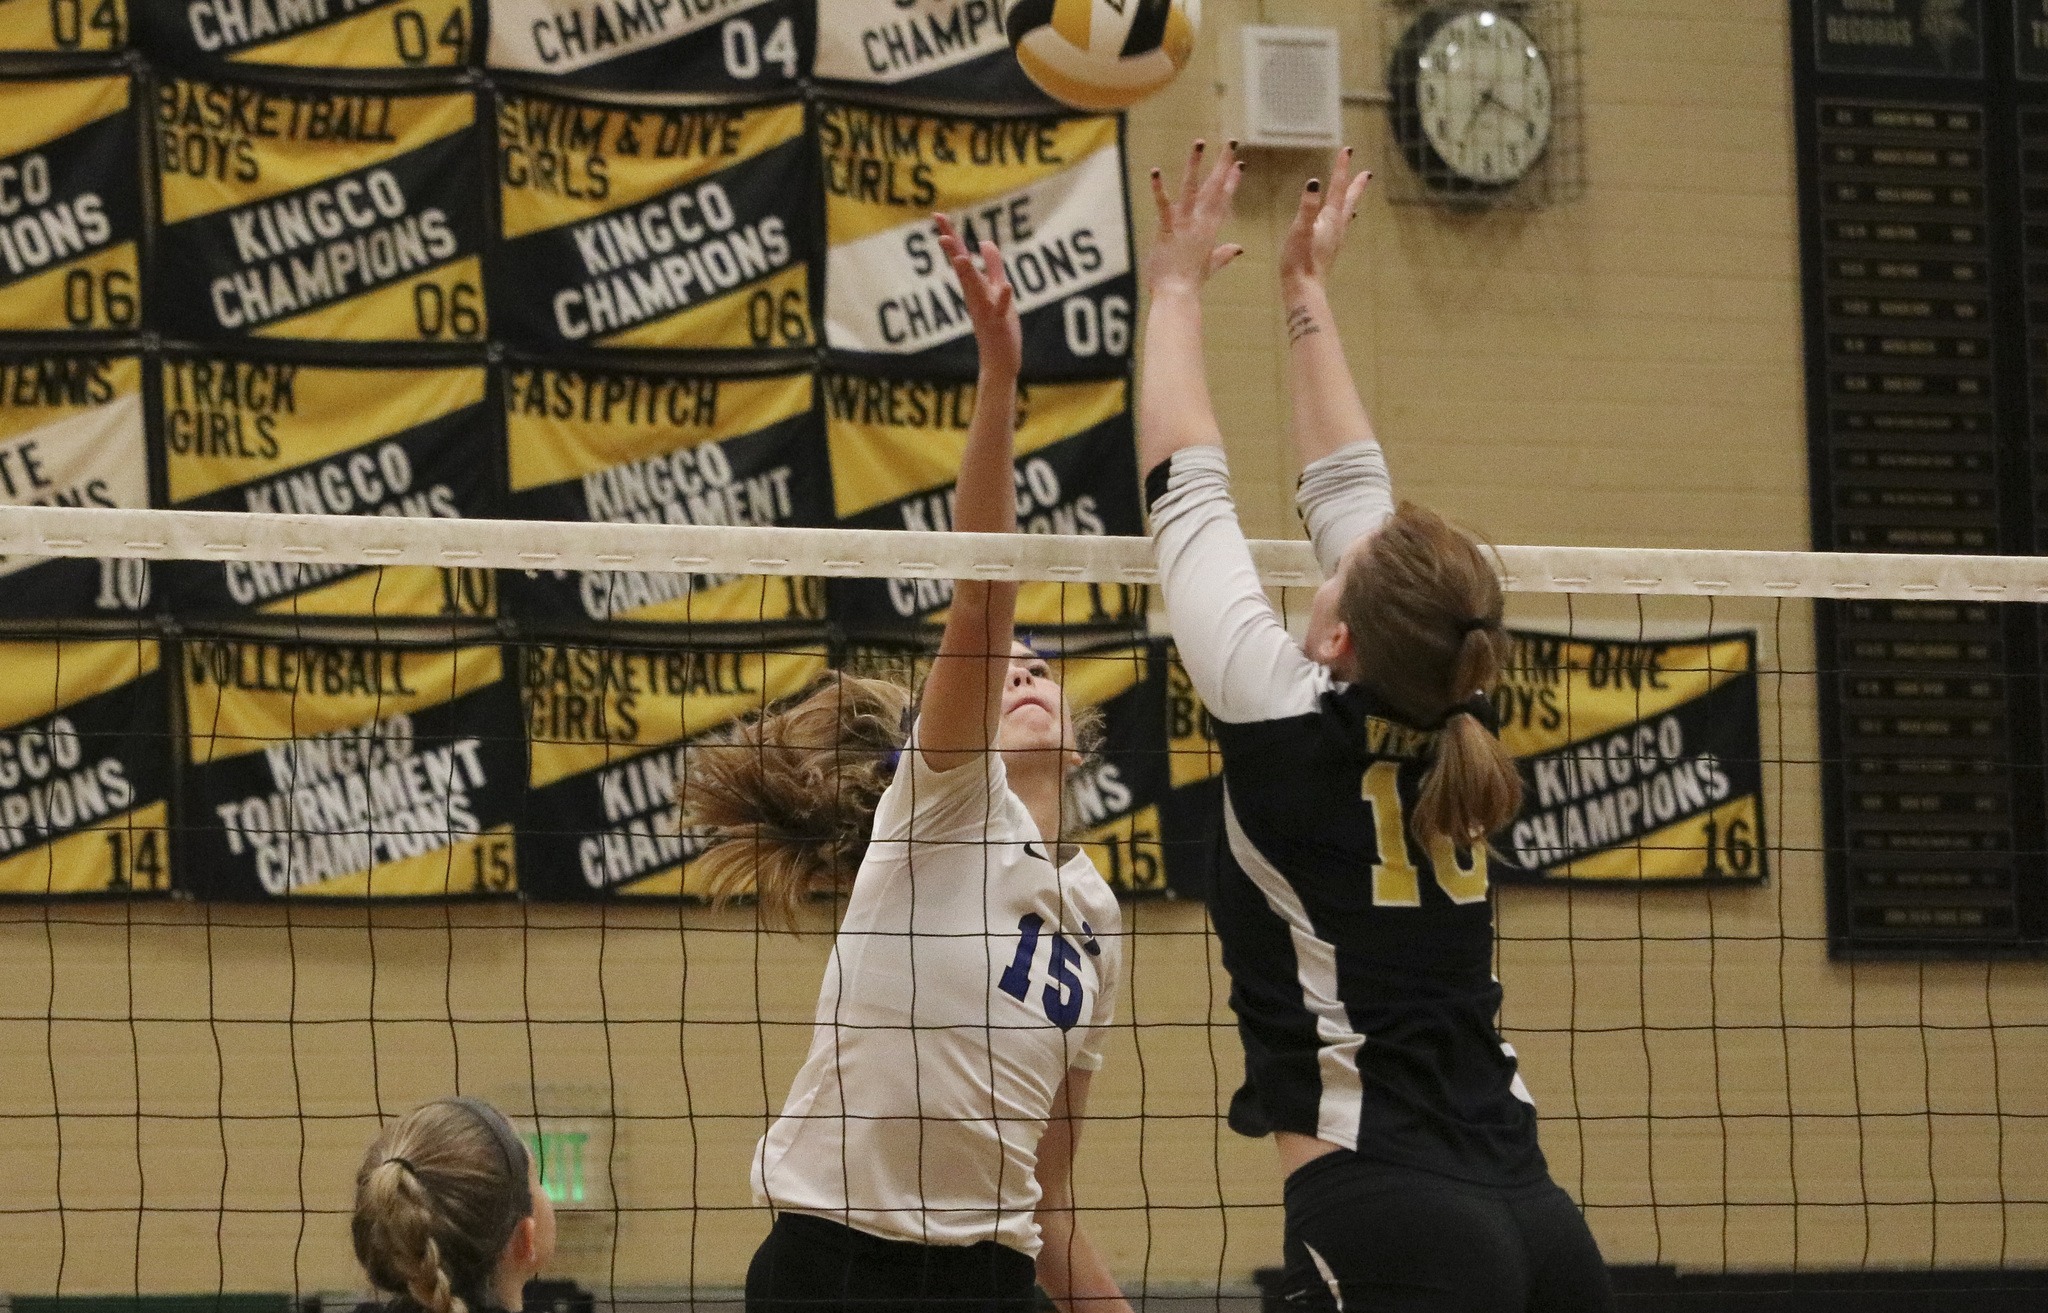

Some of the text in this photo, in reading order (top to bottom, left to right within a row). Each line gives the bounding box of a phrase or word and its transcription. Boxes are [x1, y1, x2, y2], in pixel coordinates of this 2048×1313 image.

[393, 10, 469, 66] 04
[721, 17, 798, 79] 04
[157, 82, 396, 144] BASKETBALL
[162, 131, 260, 183] BOYS
[230, 169, 405, 263] KINGCO
[573, 183, 735, 276] KINGCO
[904, 196, 1034, 276] SATE
[66, 268, 134, 326] 06
[209, 208, 457, 328] CHAMPIONS
[553, 216, 791, 340] CHAMPIONS
[413, 282, 481, 338] 06
[748, 290, 812, 344] 06
[1063, 296, 1130, 357] 06
[163, 361, 297, 412] TRACK
[170, 410, 281, 460] GIRLS
[583, 441, 733, 521] KINGCO
[187, 643, 416, 697] VOLLEYBALL
[525, 648, 757, 695] BASKETBALL
[530, 691, 640, 741] GIRLS
[1533, 714, 1682, 808] KINGCO
[1512, 752, 1730, 870] CHAMPIONS
[107, 832, 161, 890] 14
[472, 843, 512, 892] 15
[1102, 832, 1157, 890] 15
[1703, 818, 1751, 874] 16
[997, 912, 1084, 1034] 15
